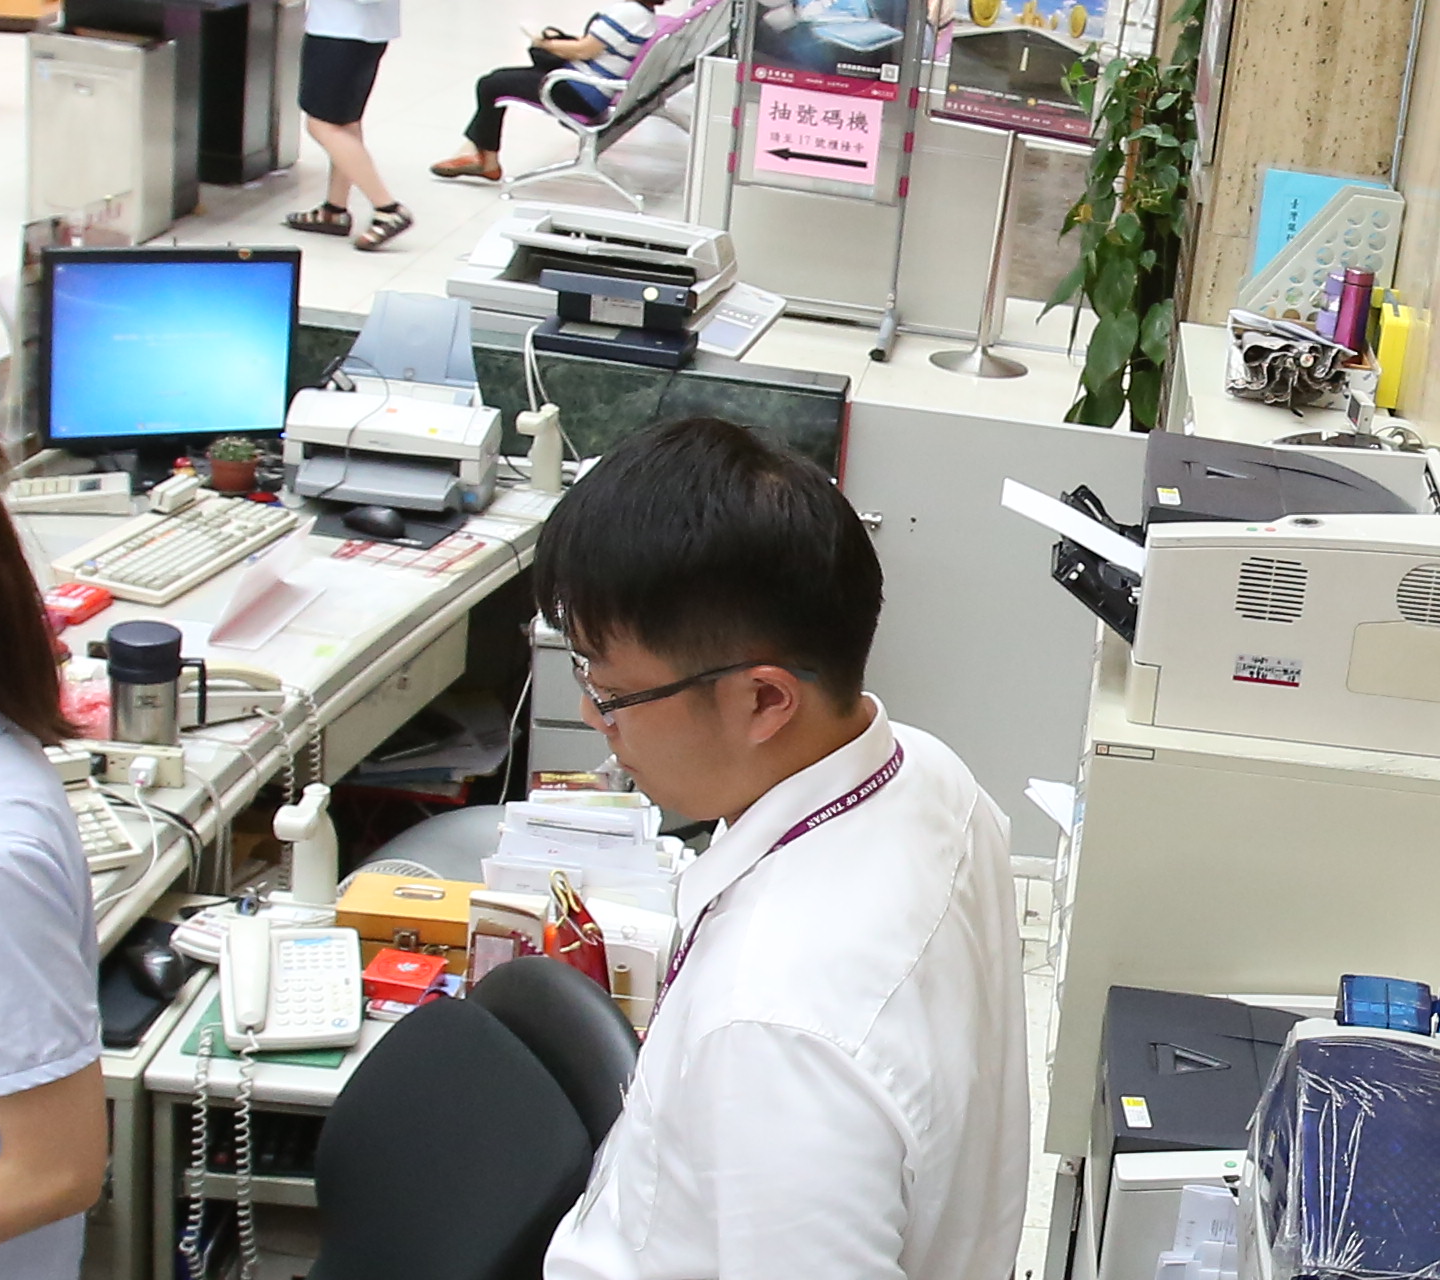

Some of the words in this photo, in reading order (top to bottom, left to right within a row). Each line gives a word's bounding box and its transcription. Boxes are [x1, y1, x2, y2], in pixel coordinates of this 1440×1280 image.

[768, 100, 869, 134] 抽號碼機
[806, 802, 845, 829] TAIWAN
